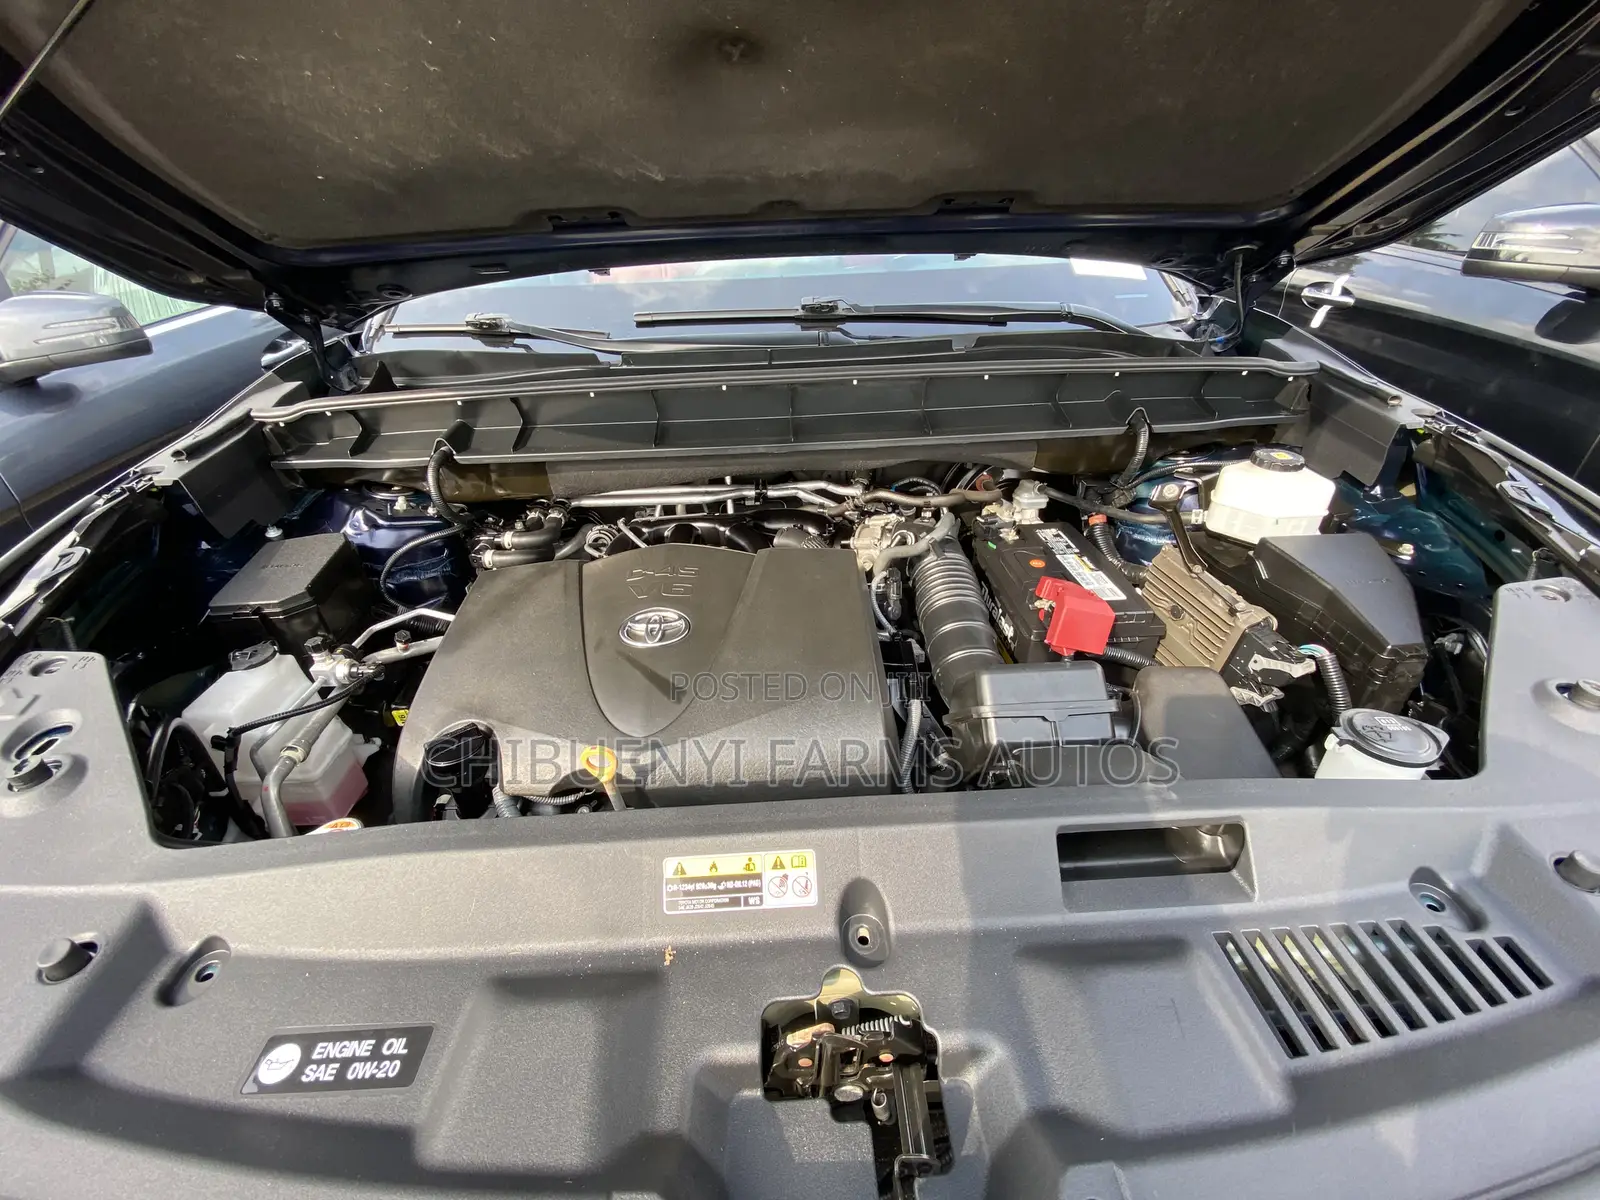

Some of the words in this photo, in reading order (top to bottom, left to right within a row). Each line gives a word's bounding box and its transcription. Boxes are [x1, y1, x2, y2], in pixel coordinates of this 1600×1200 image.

[311, 1039, 376, 1060] ENGINE
[381, 1037, 409, 1055] OIL
[301, 1062, 340, 1083] SAE
[346, 1059, 401, 1080] 0W-20
